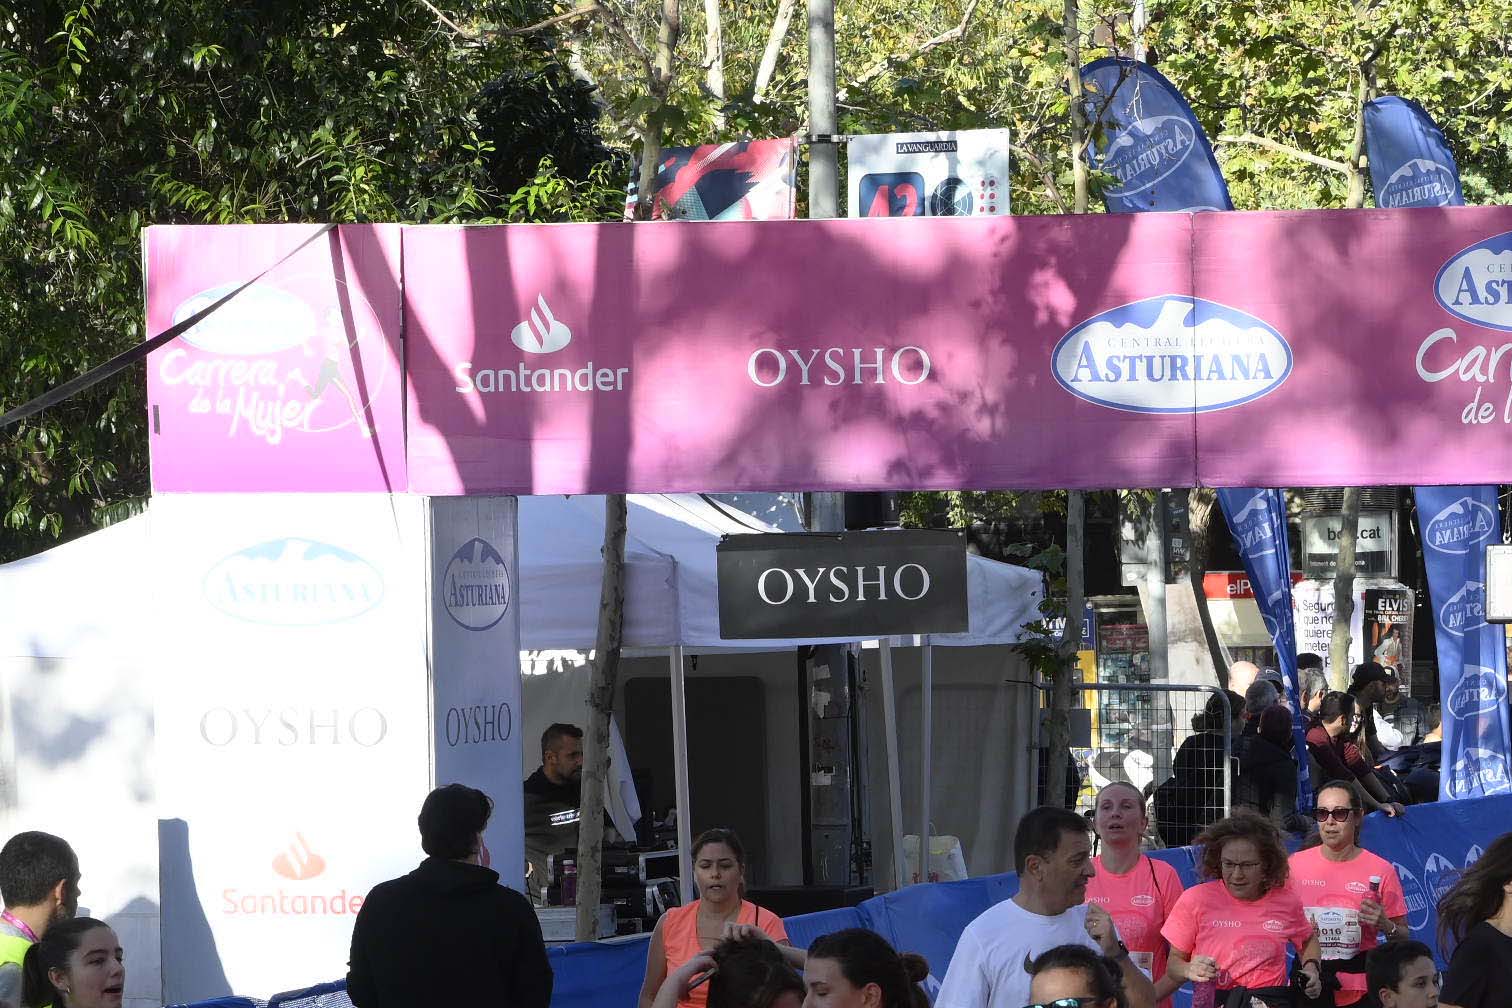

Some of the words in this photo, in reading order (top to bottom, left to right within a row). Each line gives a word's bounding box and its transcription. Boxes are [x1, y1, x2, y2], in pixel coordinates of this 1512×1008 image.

[1107, 335, 1182, 347] CENTRAL
[159, 349, 278, 390] Carrera
[456, 361, 629, 394] Santander
[747, 346, 932, 388] OYSHO
[1070, 340, 1275, 383] ASTURIANA
[228, 389, 316, 446] Mujer
[1462, 386, 1496, 426] de
[448, 574, 506, 608] ASTURIANA
[758, 563, 930, 605] OYSHO
[1378, 599, 1409, 611] ELVIS
[199, 705, 388, 747] OYSHO
[446, 703, 512, 747] OYSHO
[222, 887, 365, 917] Santande
[1213, 920, 1241, 928] OYSHO
